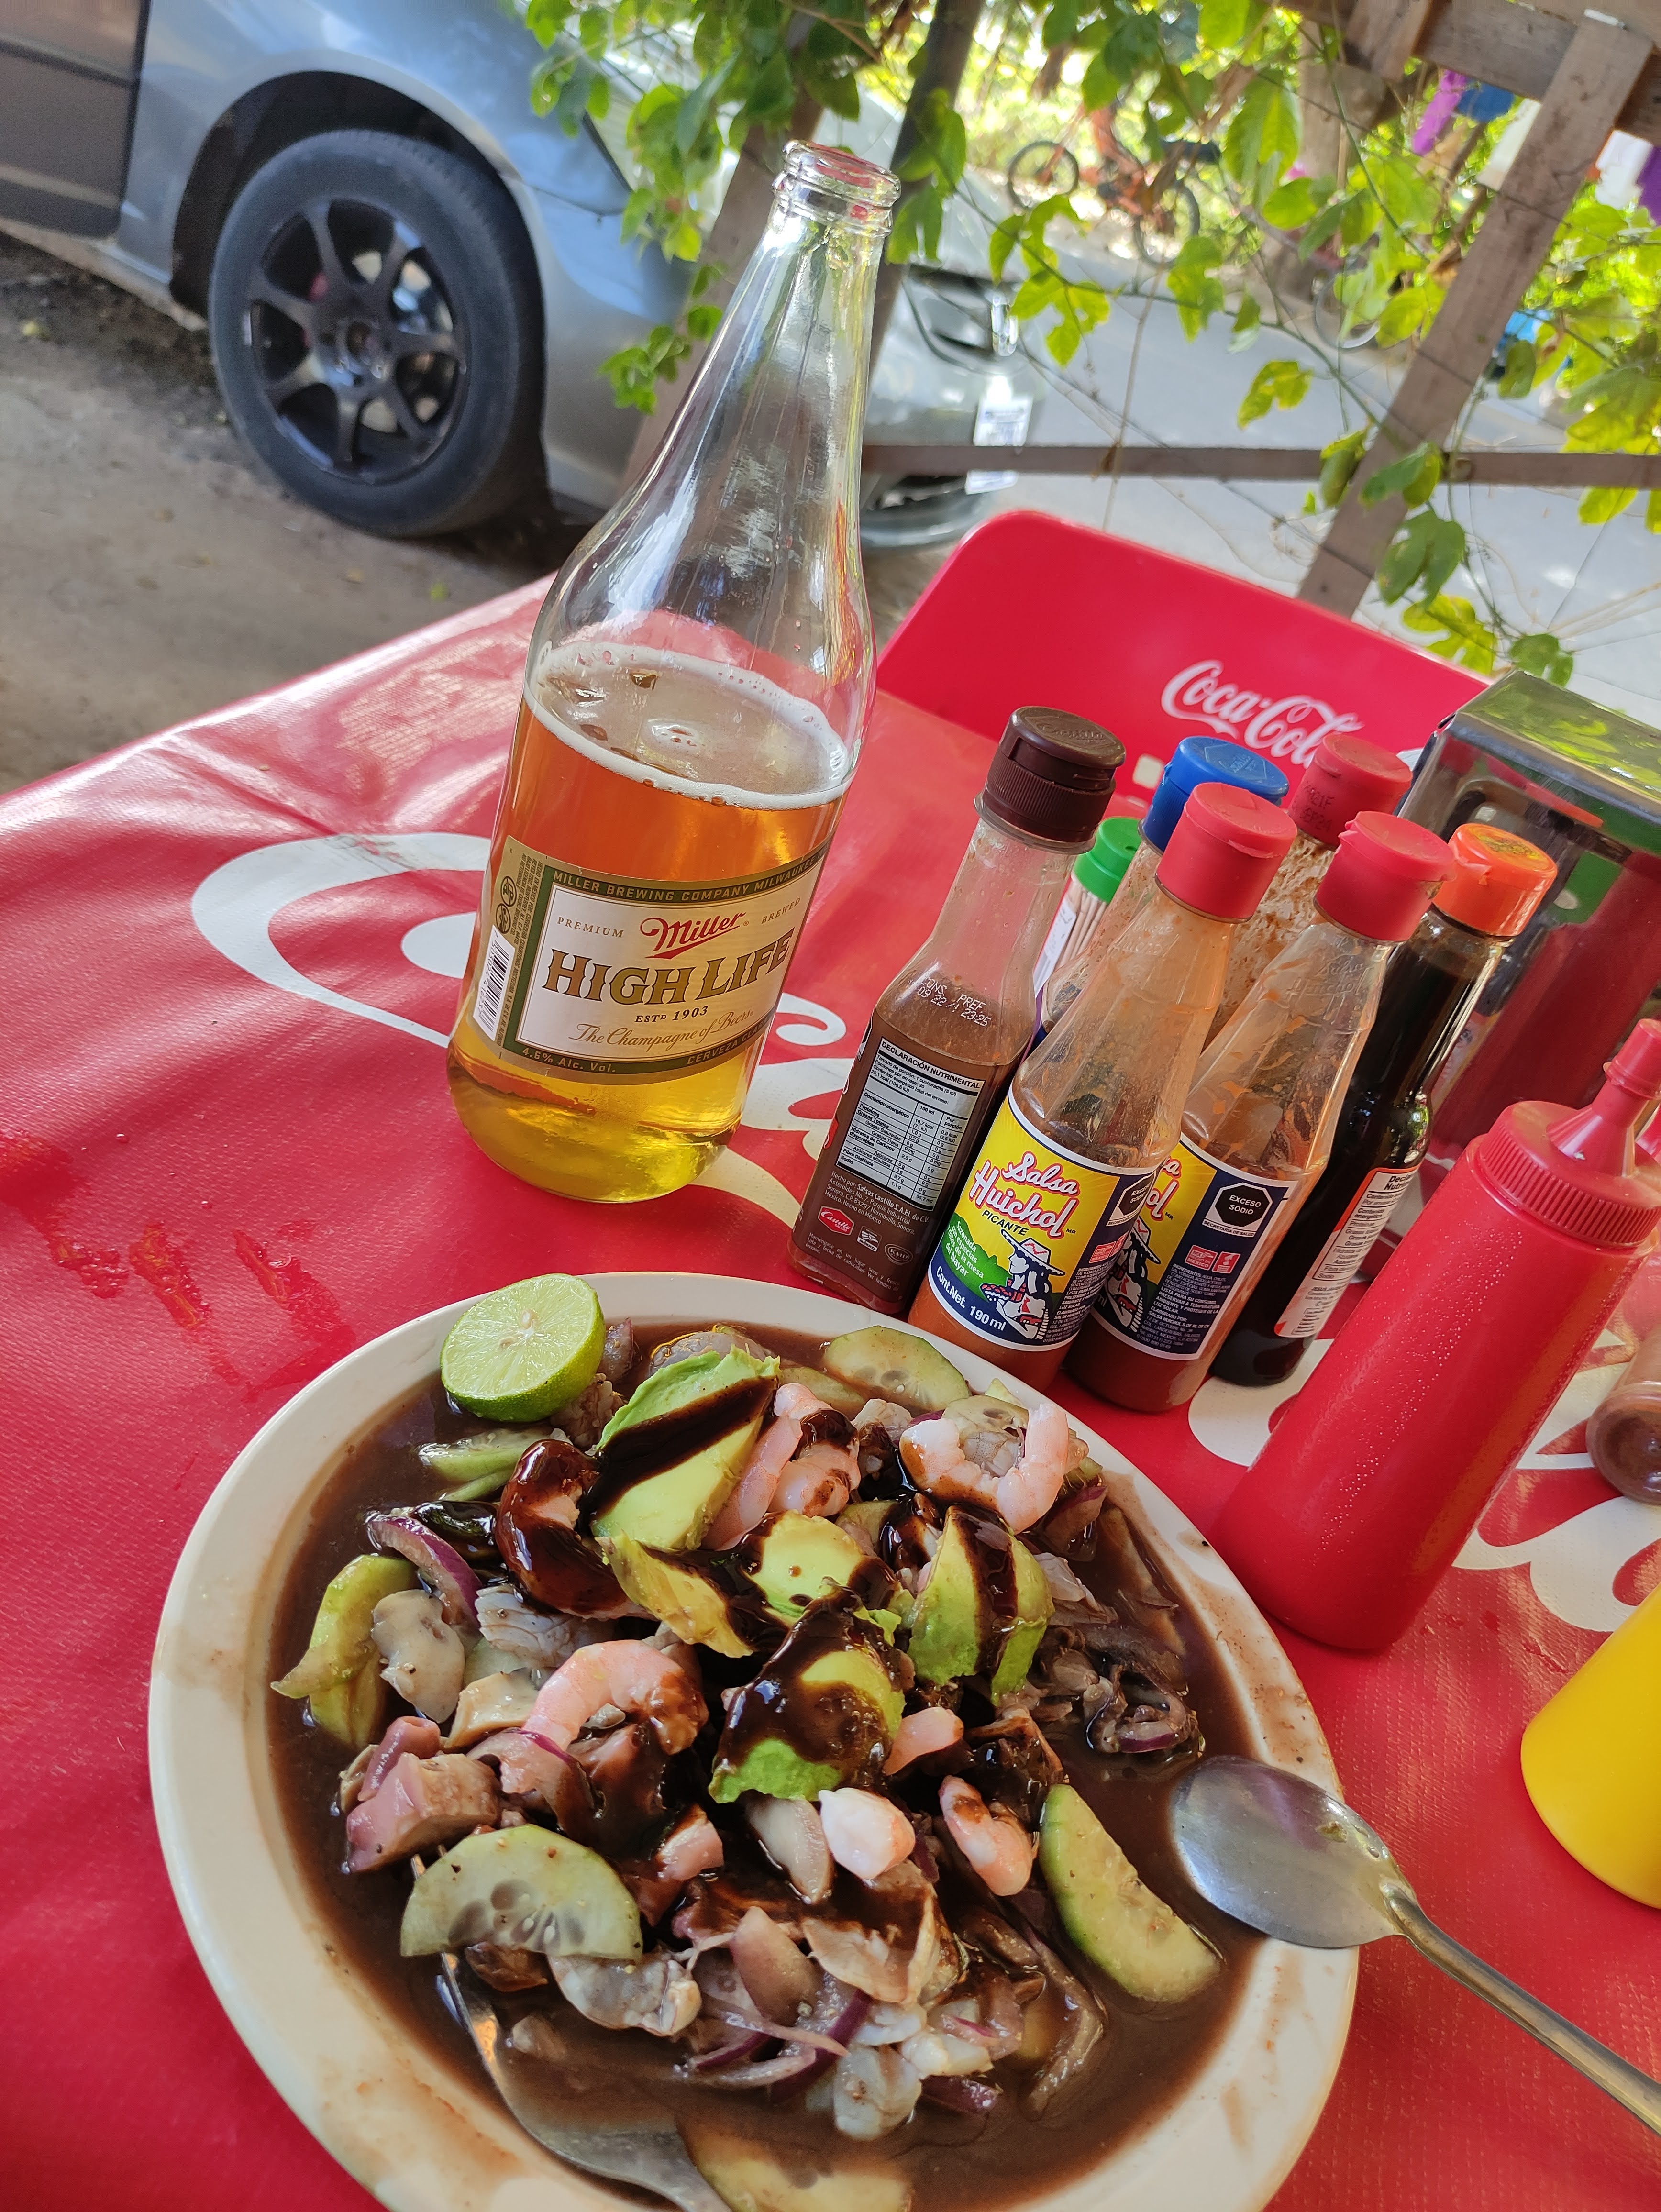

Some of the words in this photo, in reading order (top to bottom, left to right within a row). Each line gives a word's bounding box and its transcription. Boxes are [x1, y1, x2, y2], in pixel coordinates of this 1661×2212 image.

[1161, 659, 1365, 768] Coca-Col
[521, 853, 527, 861] NO
[529, 858, 538, 873] REYES
[534, 861, 544, 877] HECHO
[554, 871, 600, 892] MILLER
[607, 885, 674, 901] BREWING
[682, 885, 750, 901] COMPANY
[754, 857, 816, 892] MILWAUKEE
[557, 917, 624, 938] PREMIUM
[640, 912, 746, 955] Miller
[761, 897, 801, 924] BREWED
[542, 948, 697, 1005] HIGH
[694, 927, 795, 1001] LIFE
[672, 1005, 708, 1021] 1903
[568, 1023, 604, 1044] The
[607, 1027, 697, 1052] Champagne
[695, 1018, 718, 1044] of
[522, 1047, 553, 1063] 4.6%
[558, 1058, 583, 1070] Alc.
[590, 1062, 616, 1073] Vol.
[687, 1039, 738, 1065] CERVEZA
[881, 1041, 930, 1072] DECLARACIÓN
[930, 1067, 981, 1089] NUTRIMENTAL
[873, 1063, 893, 1079] Contenido
[931, 1094, 949, 1105] envase:
[874, 1059, 895, 1074] Porciones
[901, 1075, 919, 1086] envase:
[876, 1054, 893, 1067] Tamaño
[919, 1077, 944, 1092] cucharadita
[879, 1073, 890, 1082] kcal
[863, 1092, 886, 1107] Contenido
[885, 1104, 910, 1119] energético
[857, 1109, 873, 1121] Grasas
[873, 1117, 889, 1129] Totales
[864, 1119, 880, 1131] Grasas
[880, 1128, 902, 1141] Saturadas
[871, 1130, 887, 1141] Grasas
[886, 1138, 899, 1147] Trans
[875, 1139, 896, 1152] Carbono
[840, 1155, 854, 1165] Sodio
[842, 1148, 855, 1157] Fibra
[1001, 1152, 1079, 1194] Salsa
[829, 1177, 855, 1195] Asteroides
[854, 1191, 864, 1200] No.
[869, 1199, 887, 1213] Parque
[886, 1208, 911, 1225] Industrial
[830, 1171, 847, 1183] Hecho
[845, 1179, 857, 1189] por:
[856, 1183, 875, 1197] Salsas
[874, 1193, 895, 1208] Castillo
[969, 1160, 1078, 1238] Huichol
[1229, 1194, 1262, 1208] EXCESO
[823, 1189, 843, 1204] México.
[842, 1200, 858, 1212] Hecho
[864, 1211, 882, 1225] México
[826, 1183, 846, 1198] Sonora,
[853, 1197, 871, 1211] 83297
[870, 1206, 897, 1226] Hermosillo,
[1165, 1212, 1174, 1220] MR
[1228, 1204, 1254, 1215] SODIO
[819, 1208, 852, 1231] Castillo
[982, 1210, 1029, 1236] PICANTE
[1204, 1220, 1232, 1233] SECRETARÍA
[957, 1221, 977, 1252] Sazonada
[957, 1235, 977, 1264] especias
[806, 1237, 817, 1246] Lote
[821, 1245, 835, 1255] fecha
[842, 1257, 866, 1274] caducidad:
[866, 1272, 875, 1280] Ver
[853, 1257, 866, 1268] lugar
[868, 1266, 879, 1276] seco
[950, 1251, 969, 1277] Nayar
[955, 1246, 962, 1256] de
[961, 1251, 967, 1262] la
[966, 1259, 984, 1279] mesa
[1155, 1295, 1179, 1308] AMBIENTE
[1158, 1291, 1185, 1305] PRESERVAR
[1160, 1286, 1174, 1295] LISTA
[1174, 1292, 1187, 1300] PARA
[967, 1304, 990, 1325] 190
[988, 1316, 1007, 1331] ml
[1148, 1310, 1163, 1320] SALSA
[1162, 1316, 1181, 1326] HUICHOL
[1150, 1305, 1177, 1319] ELABORADO
